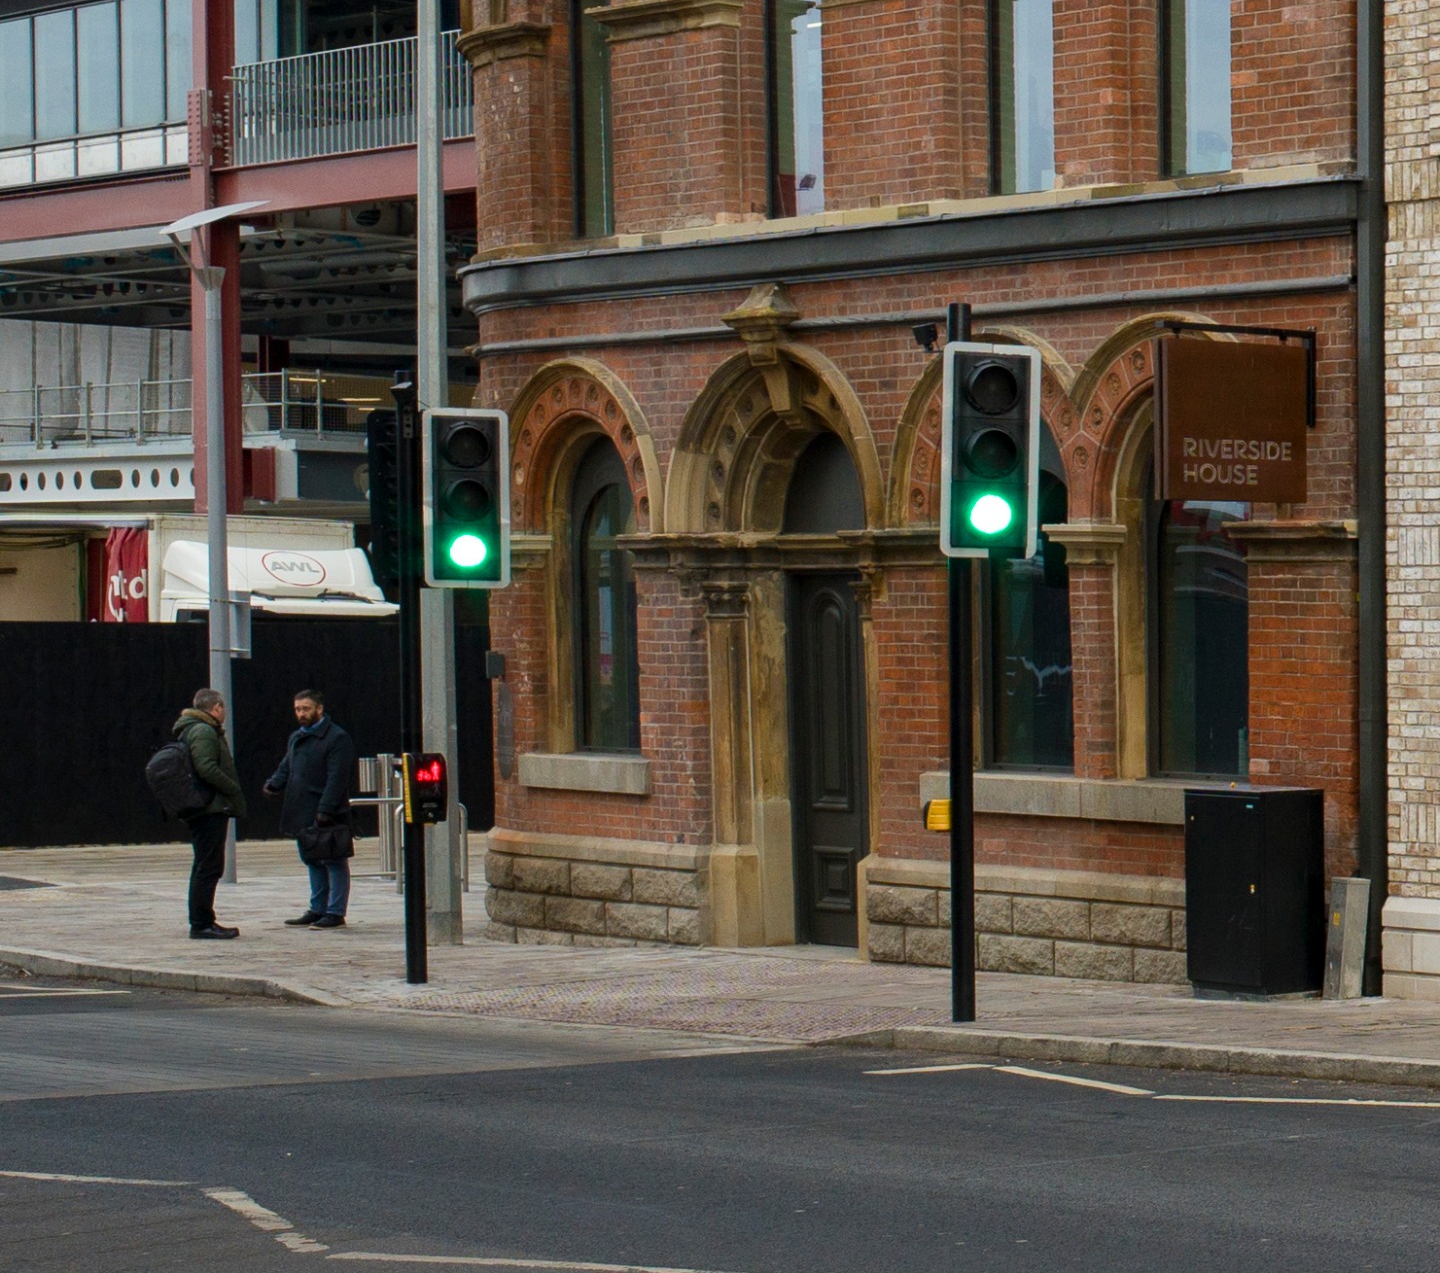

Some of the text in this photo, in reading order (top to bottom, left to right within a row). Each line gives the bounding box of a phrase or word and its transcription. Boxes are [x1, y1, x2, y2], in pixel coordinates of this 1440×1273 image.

[1183, 437, 1292, 461] RIVERSIDE
[1183, 463, 1258, 485] HOUSE
[271, 561, 320, 574] AWL
